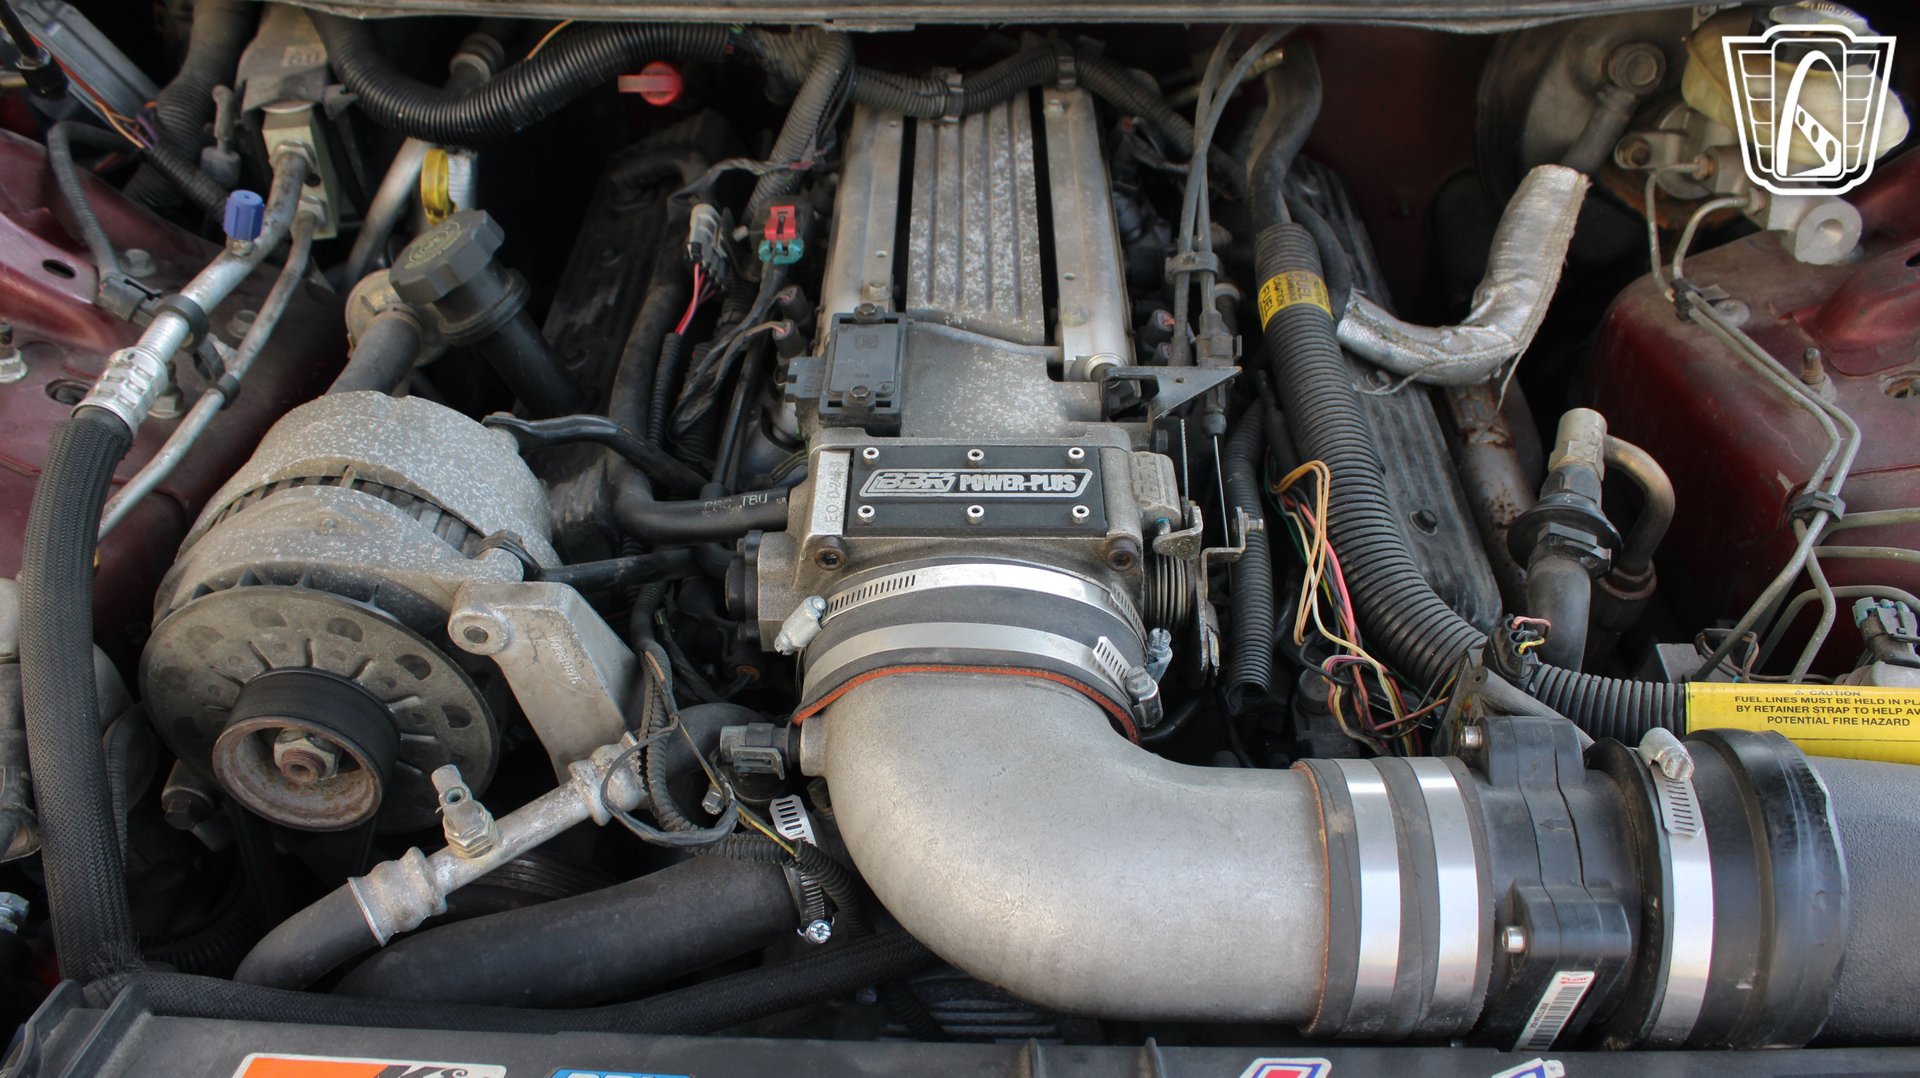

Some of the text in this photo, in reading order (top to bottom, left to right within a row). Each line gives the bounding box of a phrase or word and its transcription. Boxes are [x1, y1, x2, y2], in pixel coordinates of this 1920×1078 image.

[1261, 285, 1273, 318] FUEL
[874, 472, 1077, 491] BBK POWER-PLUS
[1765, 696, 1798, 704] LINES
[1736, 705, 1751, 713] BY
[1754, 705, 1809, 714] RETAINER
[1812, 706, 1850, 714] STRAP
[1872, 707, 1903, 715] HELP
[1767, 716, 1911, 727] POTENTIAL FIRE HAZARD
